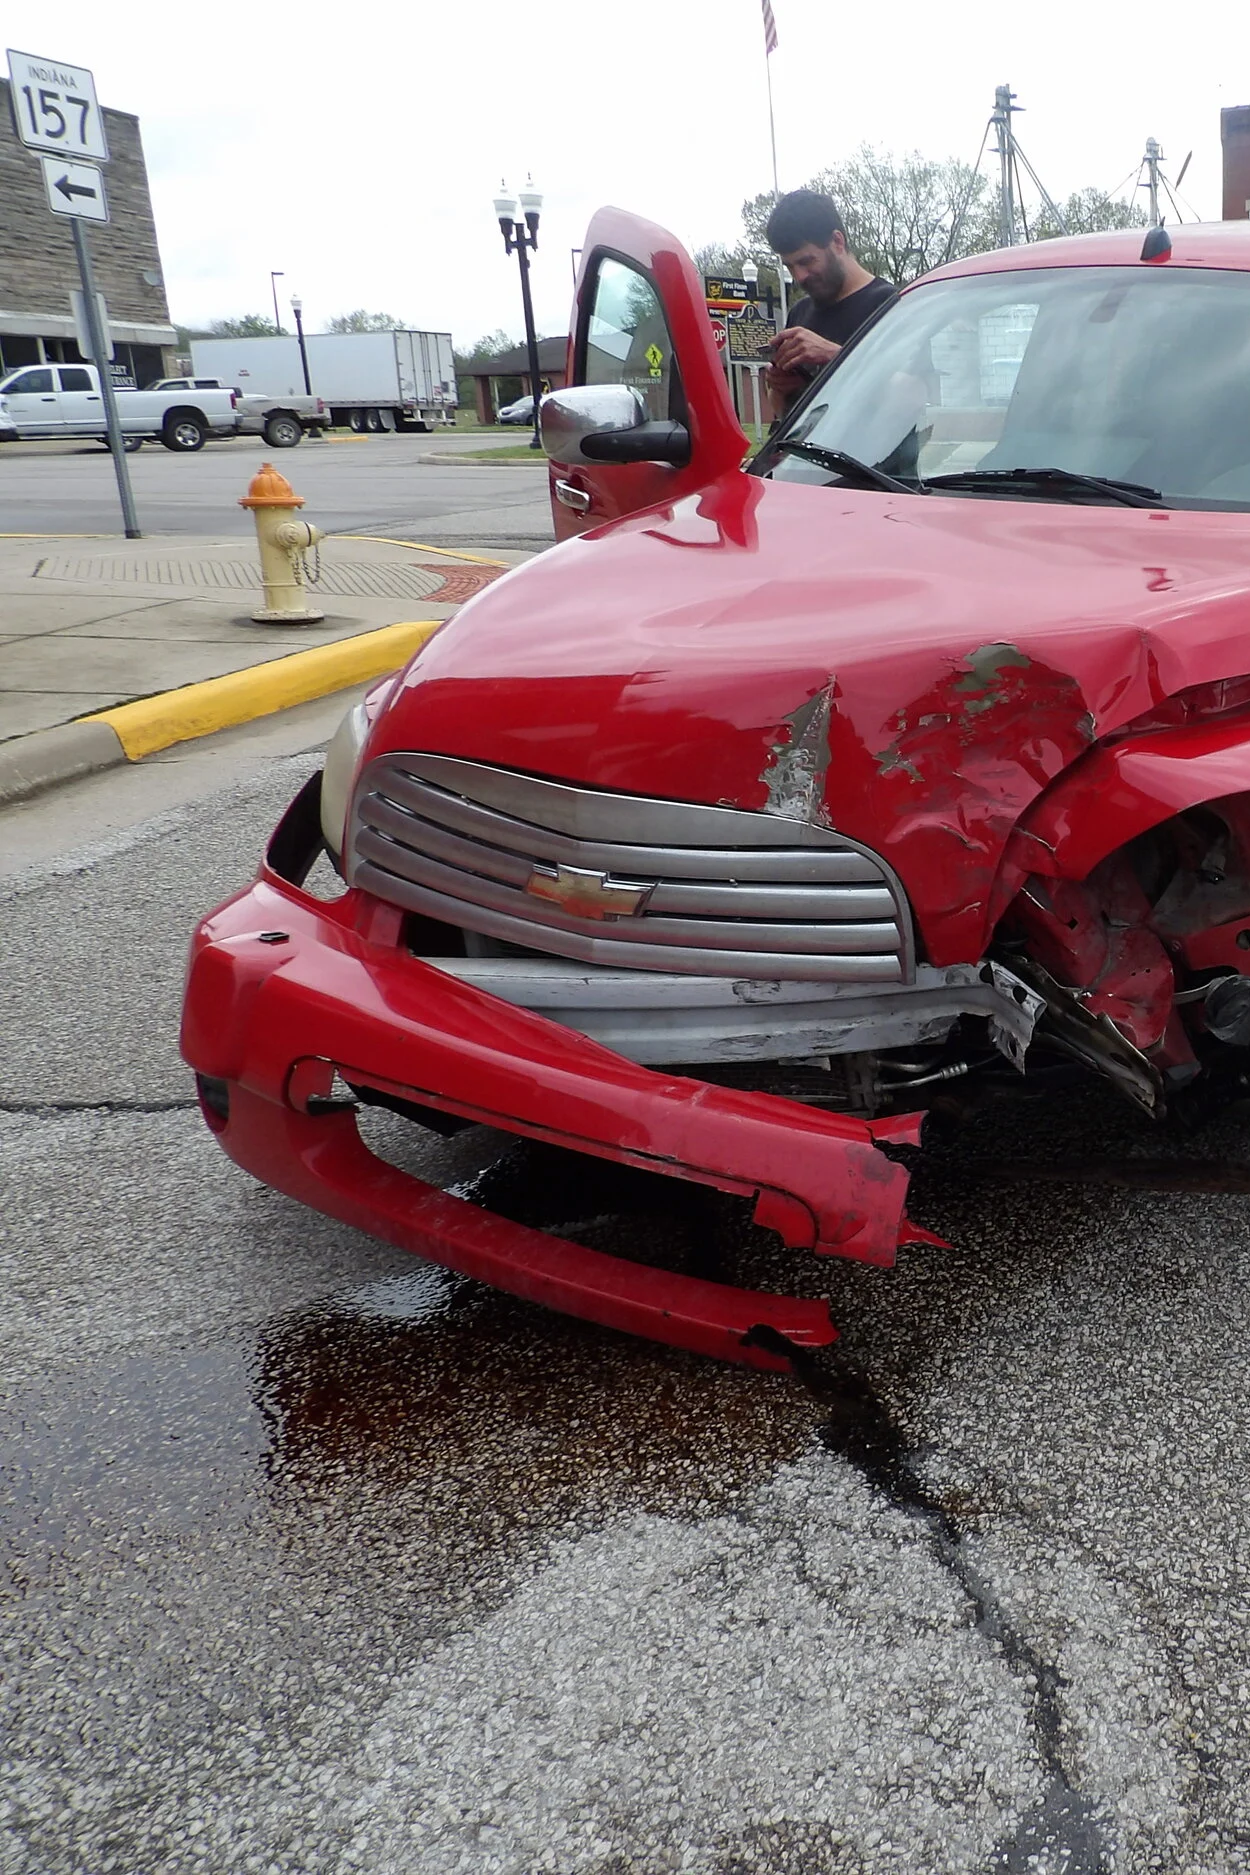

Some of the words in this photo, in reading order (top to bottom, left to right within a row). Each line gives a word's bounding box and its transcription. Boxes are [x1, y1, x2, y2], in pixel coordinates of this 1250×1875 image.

[27, 65, 79, 90] INDIANA
[22, 84, 90, 145] 157
[734, 282, 748, 290] Finan
[713, 329, 726, 341] OP
